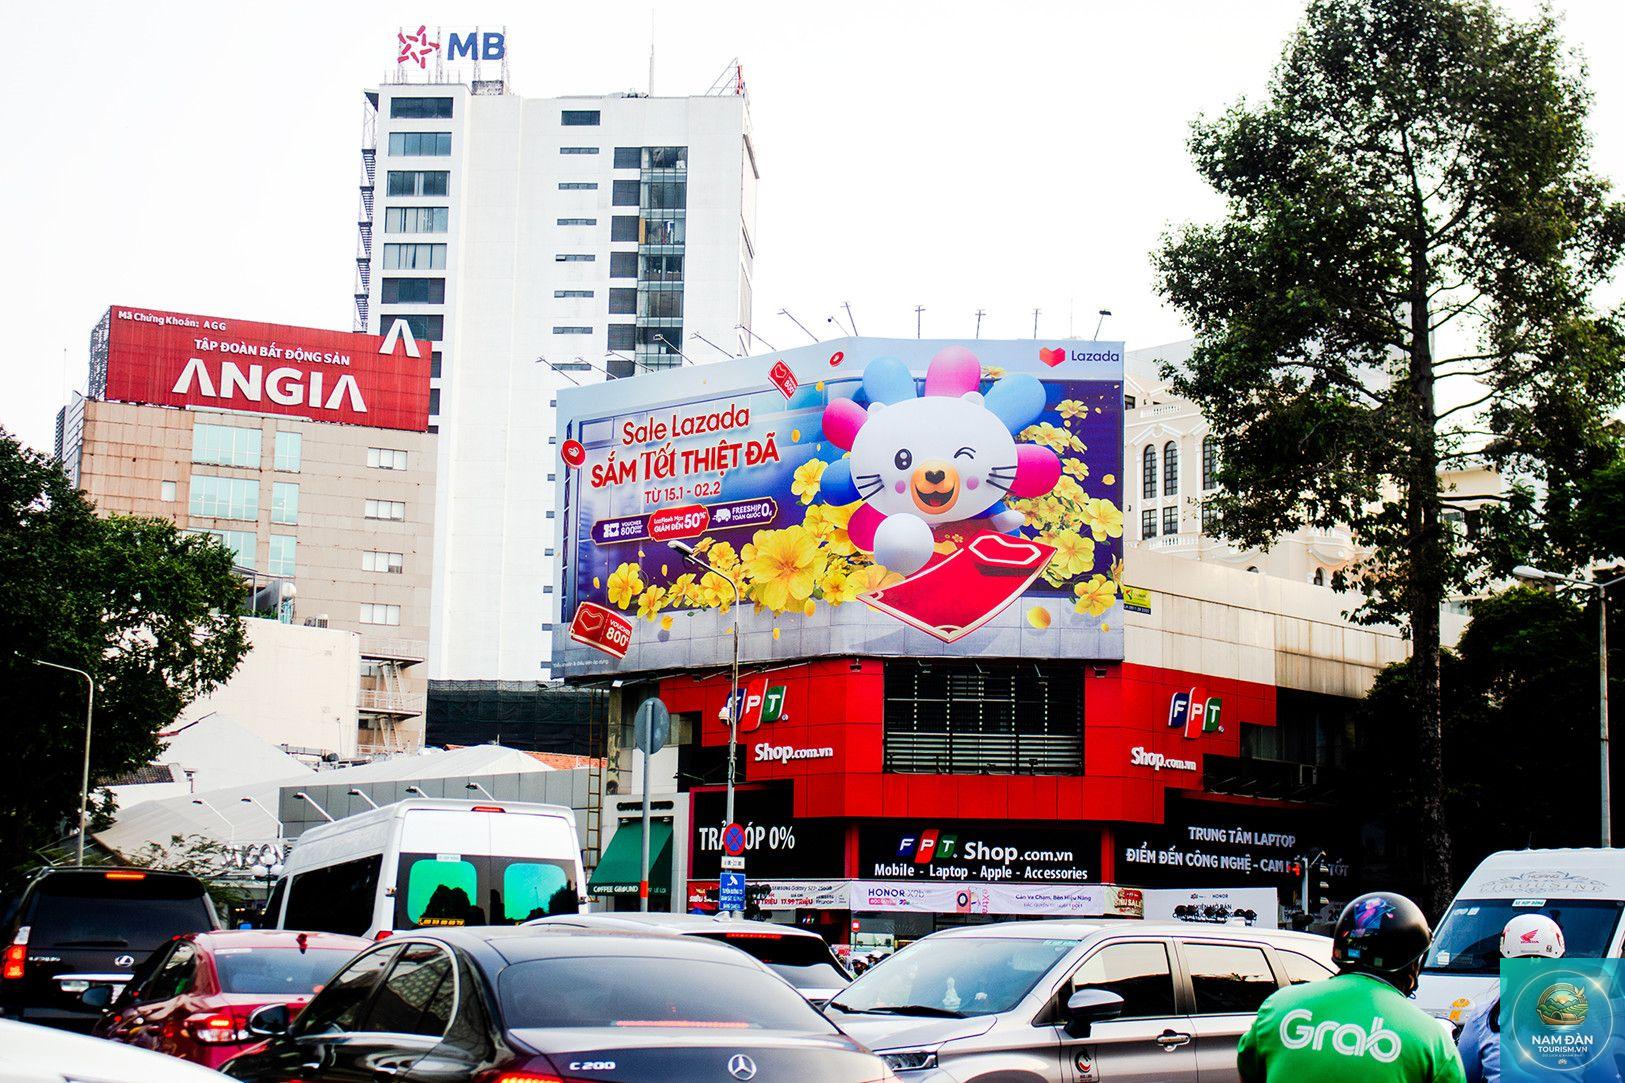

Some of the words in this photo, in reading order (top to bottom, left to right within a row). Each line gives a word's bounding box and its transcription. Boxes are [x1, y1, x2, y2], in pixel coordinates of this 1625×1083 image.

[447, 31, 506, 61] MB
[118, 310, 133, 321] Mã
[133, 311, 165, 325] Chứng
[165, 314, 199, 328] Khoán:
[203, 320, 227, 332] AGG
[194, 337, 218, 354] TẬP
[220, 342, 258, 356] ĐOÀN
[259, 340, 283, 359] BẤT
[284, 347, 322, 364] ĐỘNG
[324, 349, 350, 366] SẢN
[1071, 349, 1120, 363] Lazada
[622, 417, 667, 446] Sale
[672, 403, 750, 438] Lazada
[590, 451, 637, 489] SẮM
[640, 443, 677, 480] Tết
[681, 439, 743, 477] THIỆT
[744, 432, 780, 466] ĐÃ
[644, 486, 663, 504] TỪ
[664, 486, 684, 501] 15.1
[694, 481, 721, 499] 02.2
[732, 503, 762, 515] FREESHIP
[653, 523, 671, 533] GIẢM
[671, 521, 684, 531] ĐẾN
[754, 742, 834, 764] Shop.com.vn
[1130, 746, 1197, 771] Shop.com.vn
[769, 825, 796, 850] 0%
[1188, 826, 1227, 843] TRUNG
[1228, 827, 1252, 845] TÂM
[1254, 832, 1296, 848] LAPTOP
[1125, 841, 1157, 864] ĐIỂM
[1157, 845, 1183, 867] ĐẾN
[1185, 849, 1218, 869] CÔNG
[1220, 853, 1252, 875] NGHỆ
[1259, 858, 1284, 873] CAM
[874, 863, 915, 877] Mobile
[929, 864, 968, 880] Laptop
[980, 865, 1013, 880] Apple
[1024, 867, 1088, 880] Accessories
[593, 885, 614, 893] COFFEE
[614, 885, 639, 893] GROUND
[868, 888, 906, 898] HONOR
[1279, 1009, 1402, 1064] Grab
[569, 1062, 581, 1071] C
[582, 1061, 616, 1071] 200
